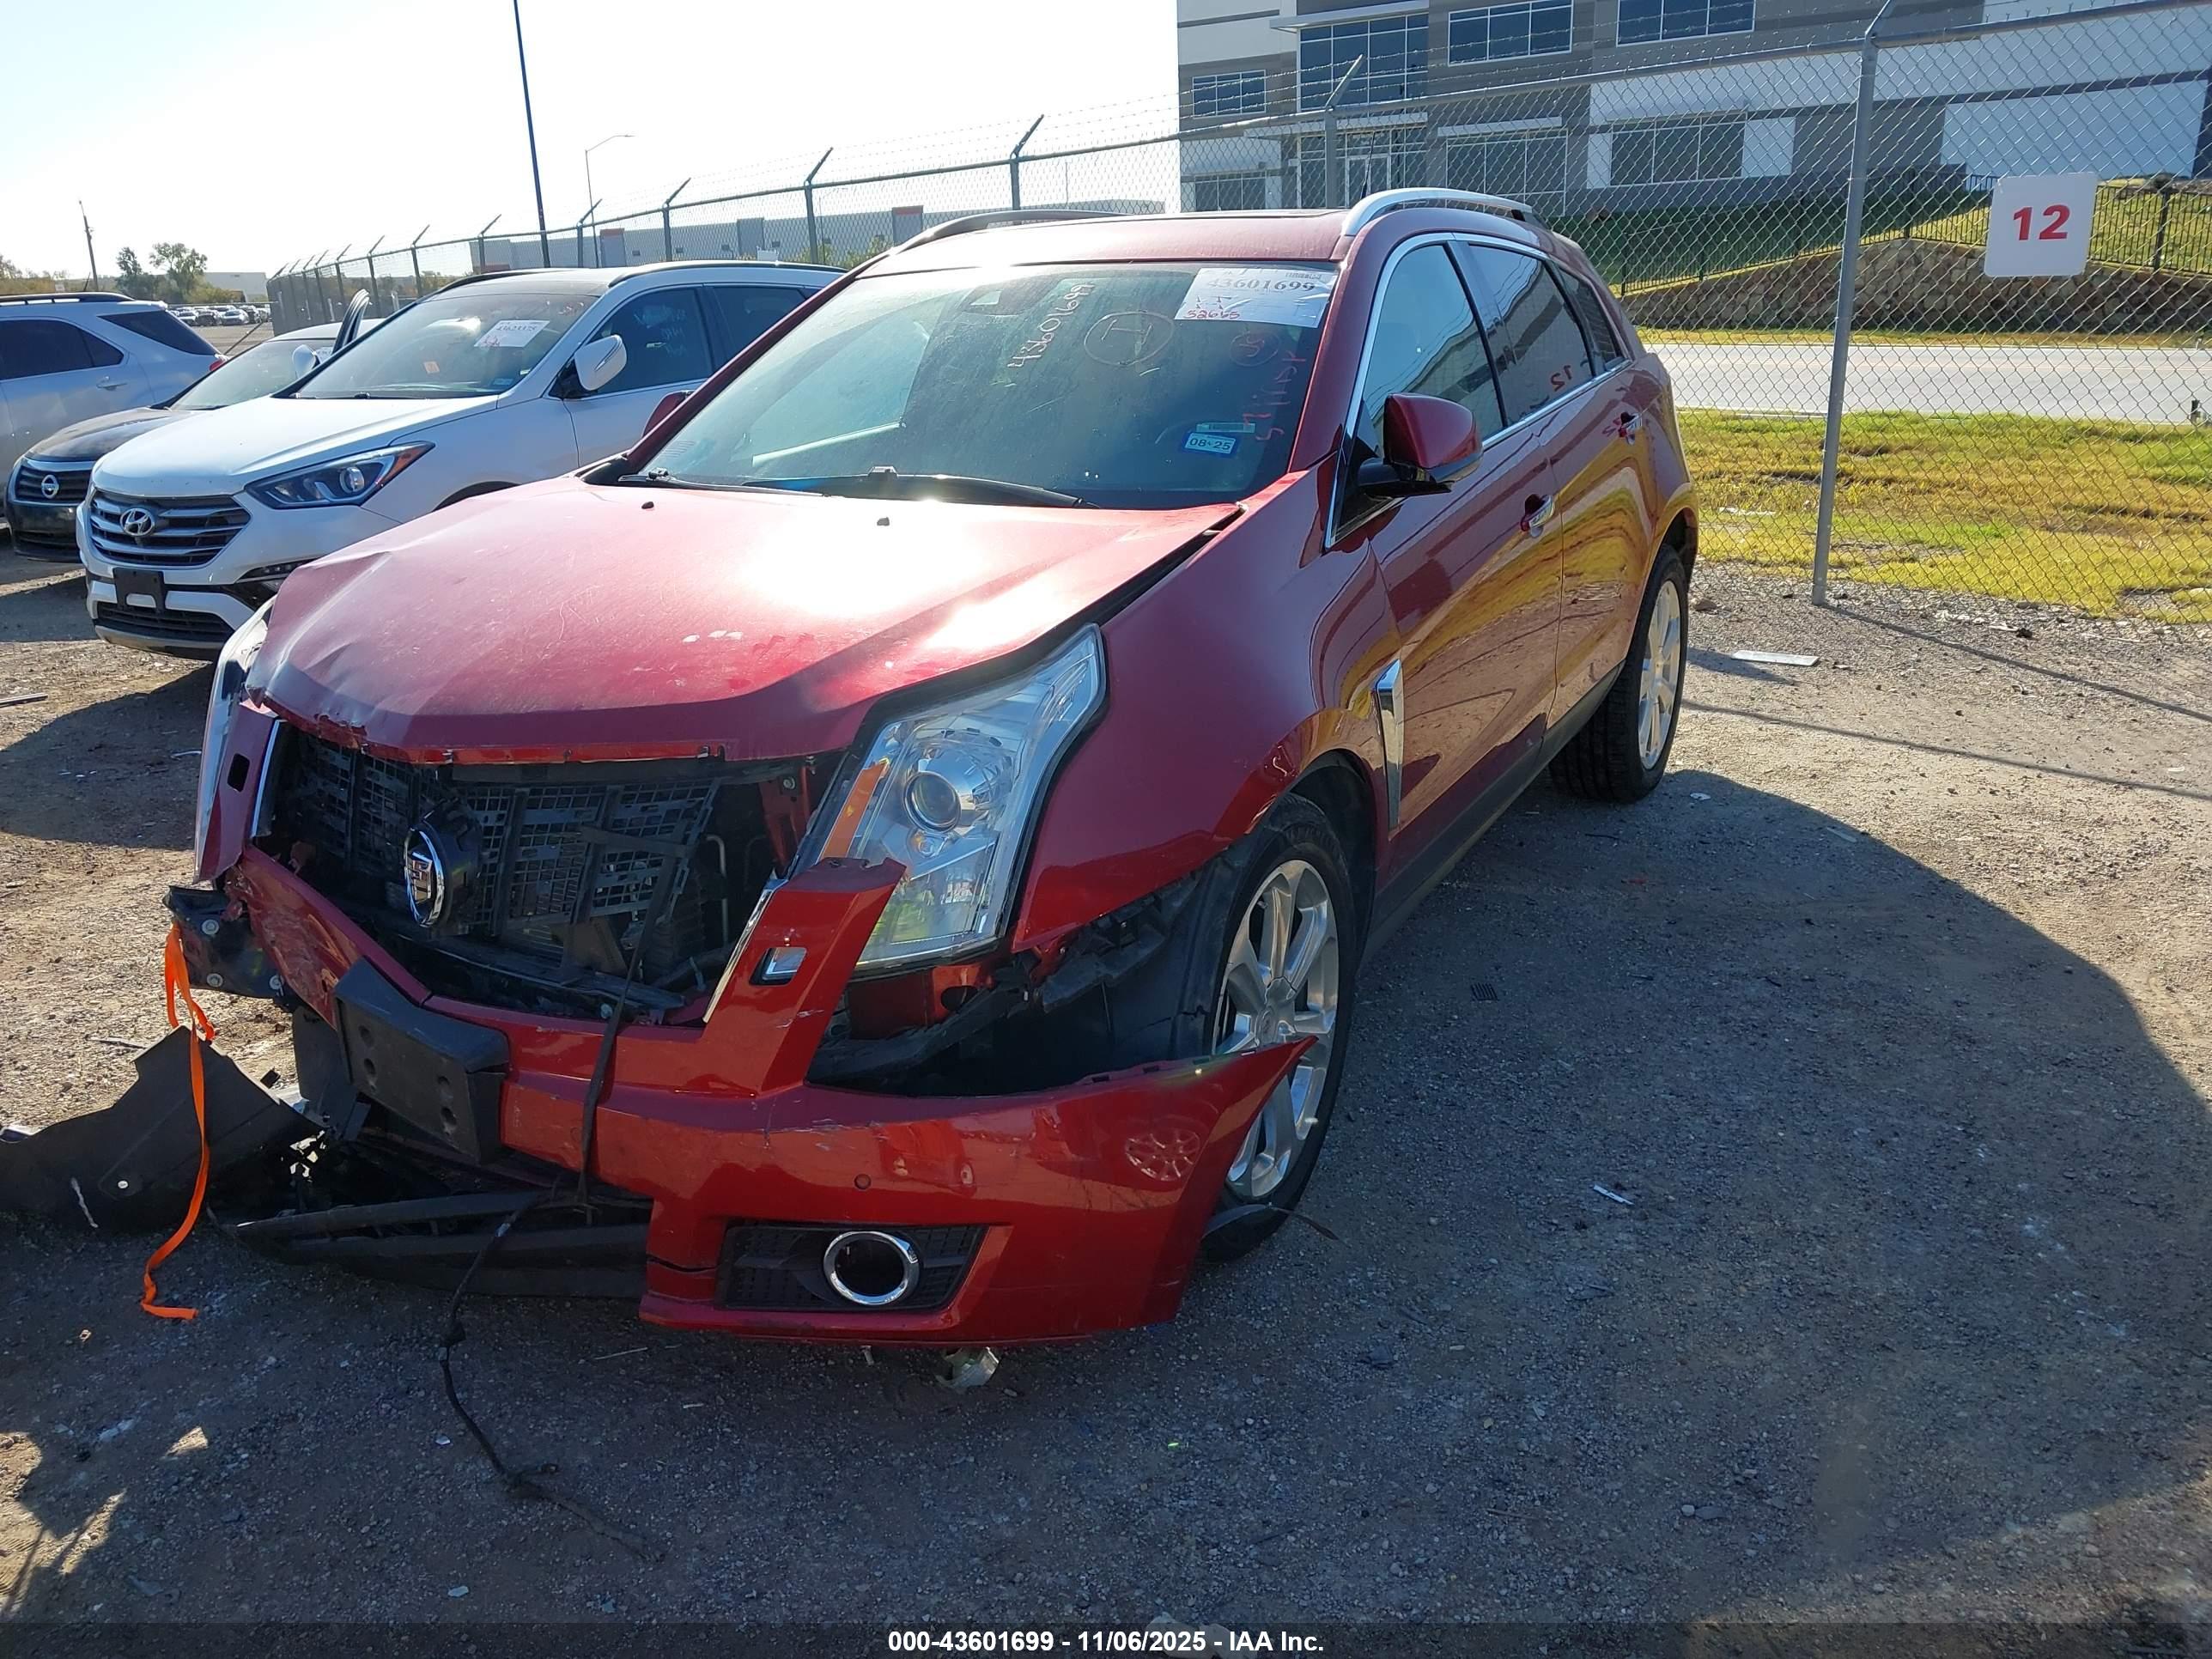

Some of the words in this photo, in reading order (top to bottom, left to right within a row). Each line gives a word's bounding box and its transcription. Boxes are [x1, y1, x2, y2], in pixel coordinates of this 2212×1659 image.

[2013, 204, 2070, 240] 12
[1208, 278, 1316, 292] 43601699
[1189, 438, 1206, 447] 08
[1213, 441, 1231, 450] 25
